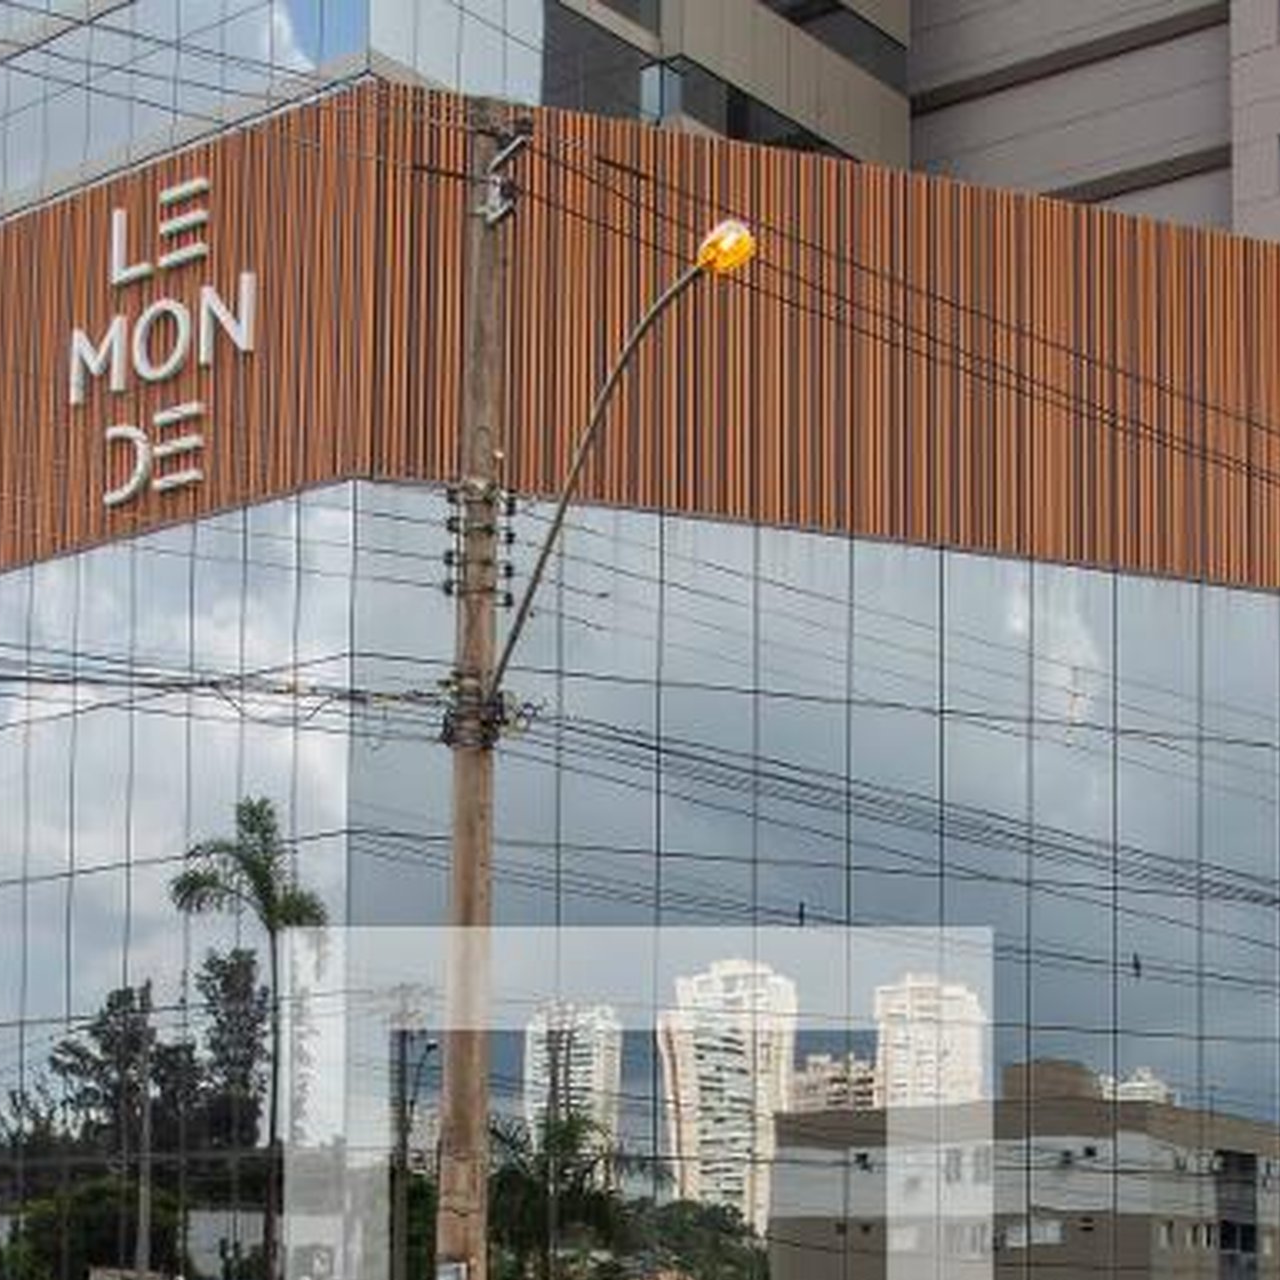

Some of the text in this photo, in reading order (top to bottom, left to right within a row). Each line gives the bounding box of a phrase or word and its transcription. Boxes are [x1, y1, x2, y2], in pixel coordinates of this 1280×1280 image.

[111, 178, 210, 285] LE
[70, 271, 257, 406] MON
[103, 402, 204, 505] DE
